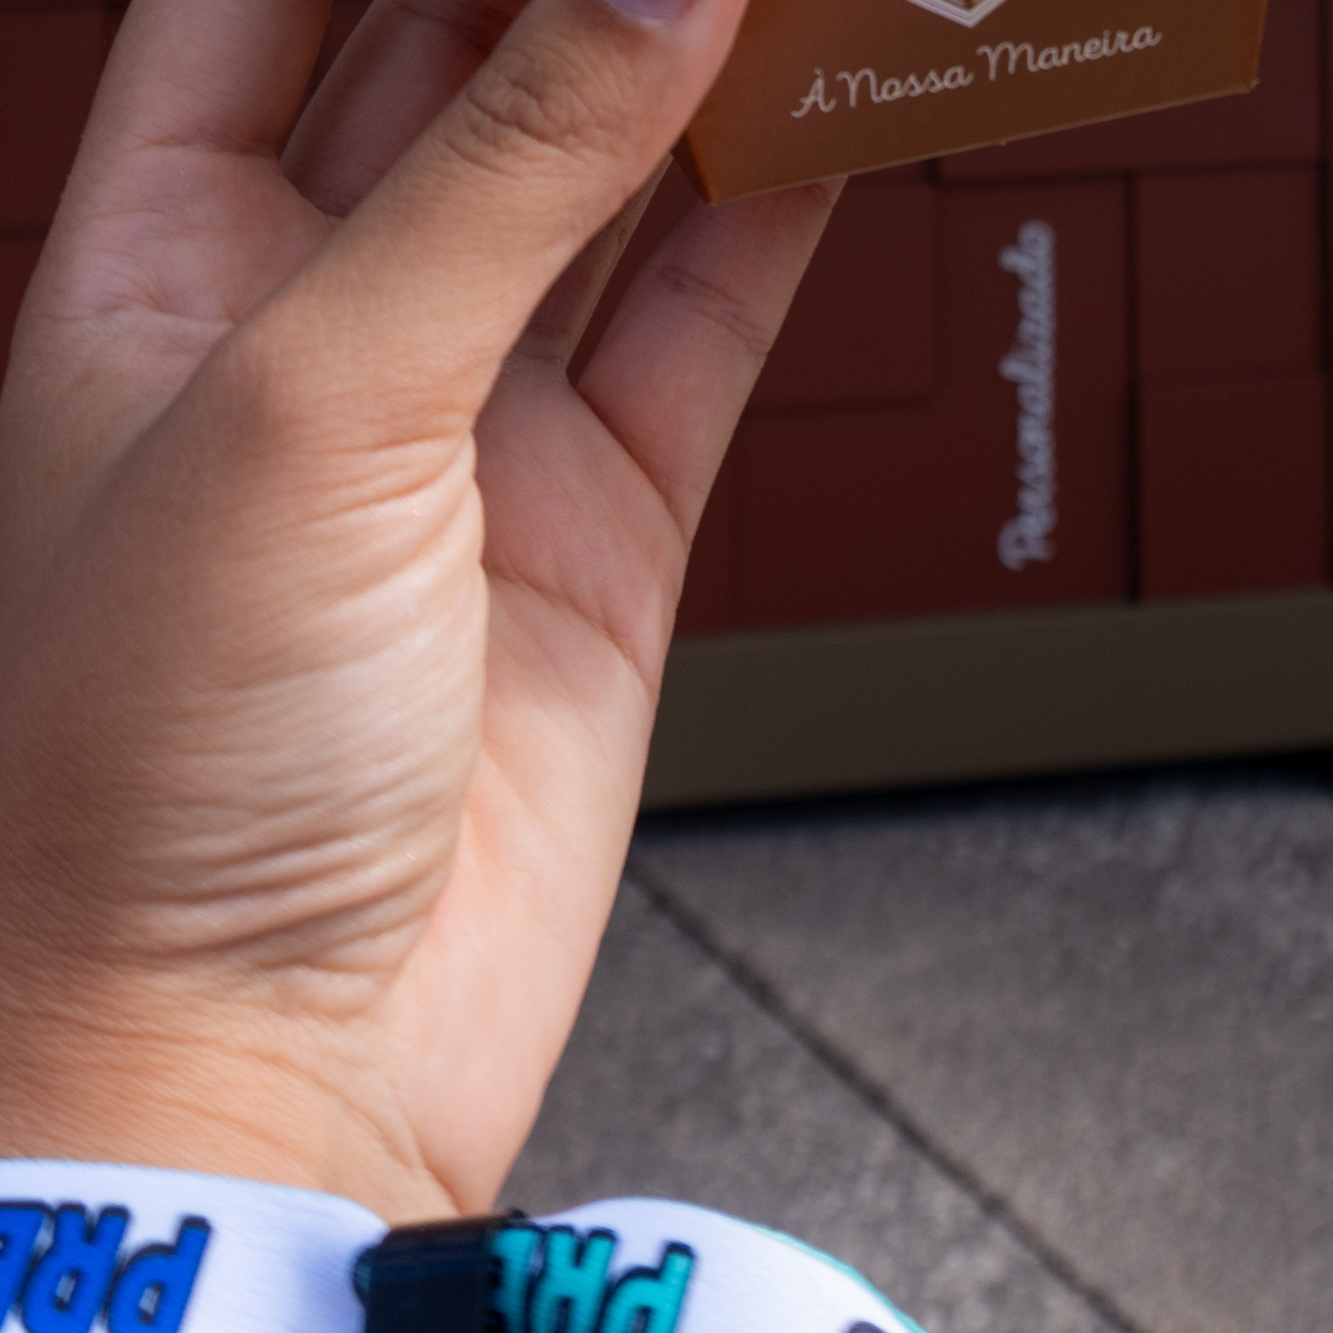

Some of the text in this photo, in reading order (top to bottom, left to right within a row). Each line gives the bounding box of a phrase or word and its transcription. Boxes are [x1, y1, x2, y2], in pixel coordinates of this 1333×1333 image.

[790, 24, 1164, 119] À Nossa Maneira
